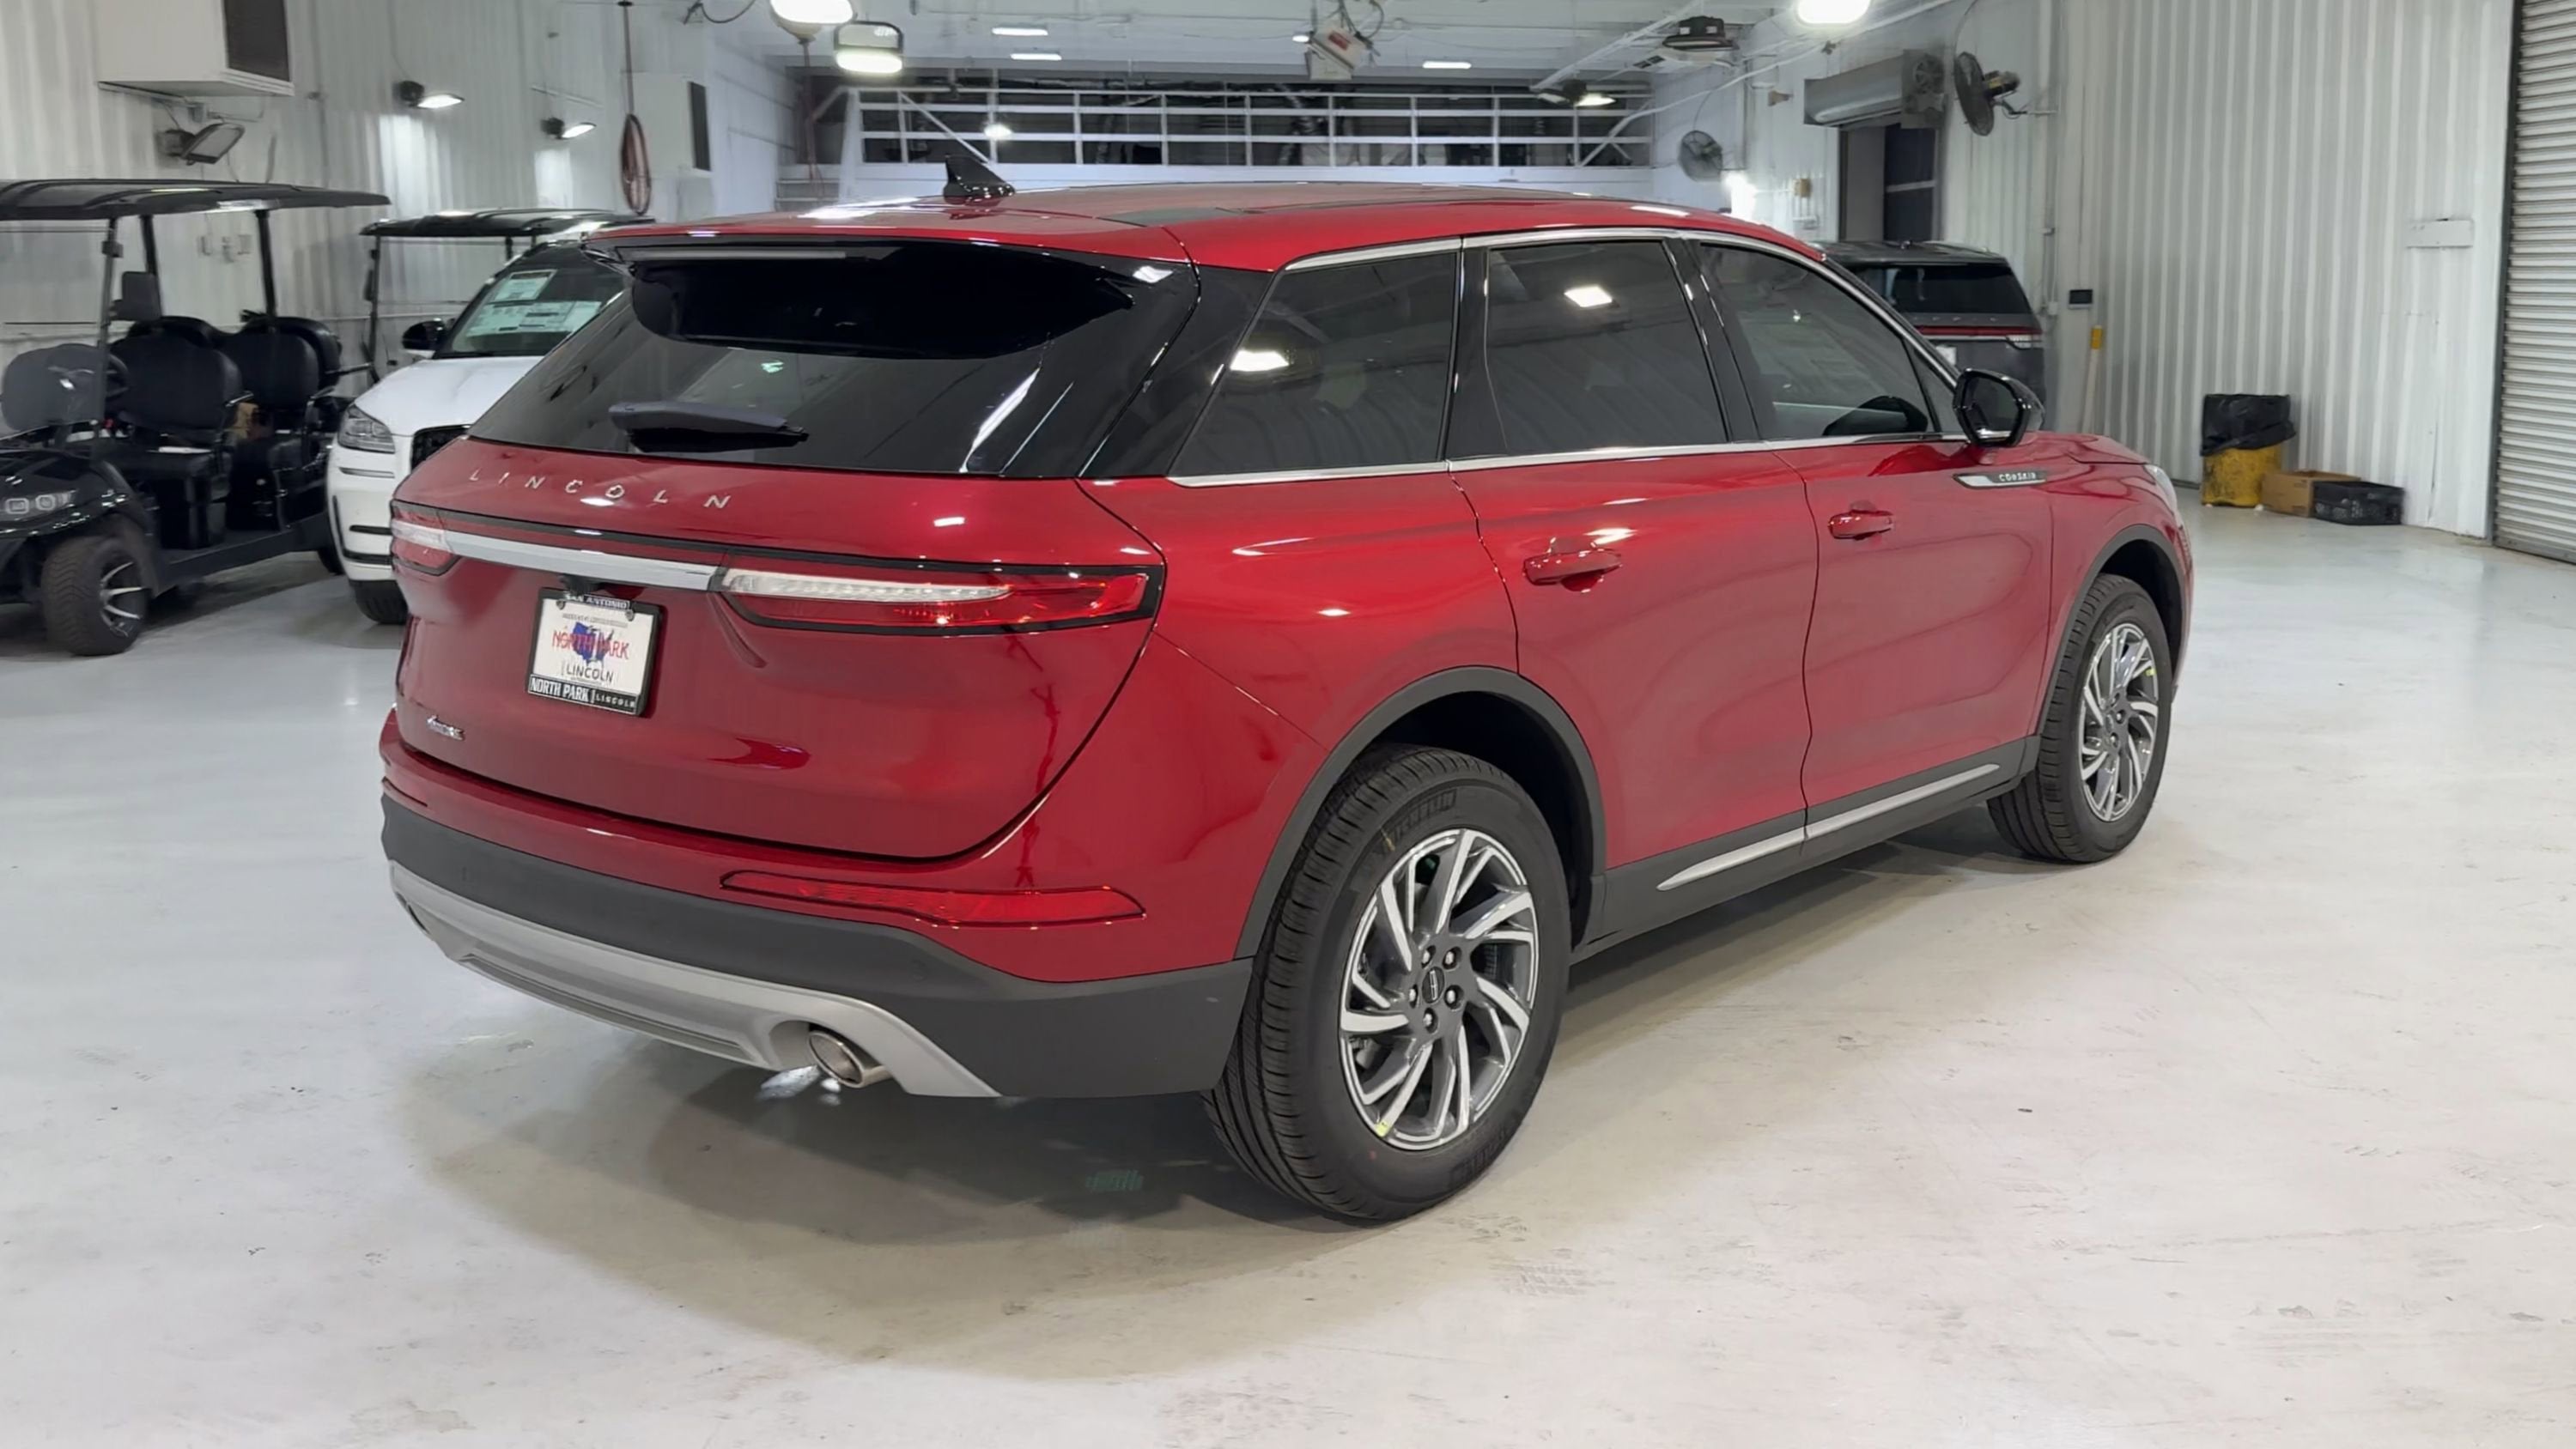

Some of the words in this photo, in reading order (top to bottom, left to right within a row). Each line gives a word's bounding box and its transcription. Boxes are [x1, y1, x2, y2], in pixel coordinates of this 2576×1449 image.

[469, 469, 731, 508] LINCOLN
[552, 631, 594, 653] NORTH
[596, 637, 629, 659] PARK
[566, 664, 614, 683] LINCOLN
[530, 676, 562, 697] NORTH
[562, 683, 589, 703] PARK
[596, 694, 636, 708] LINCOLN
